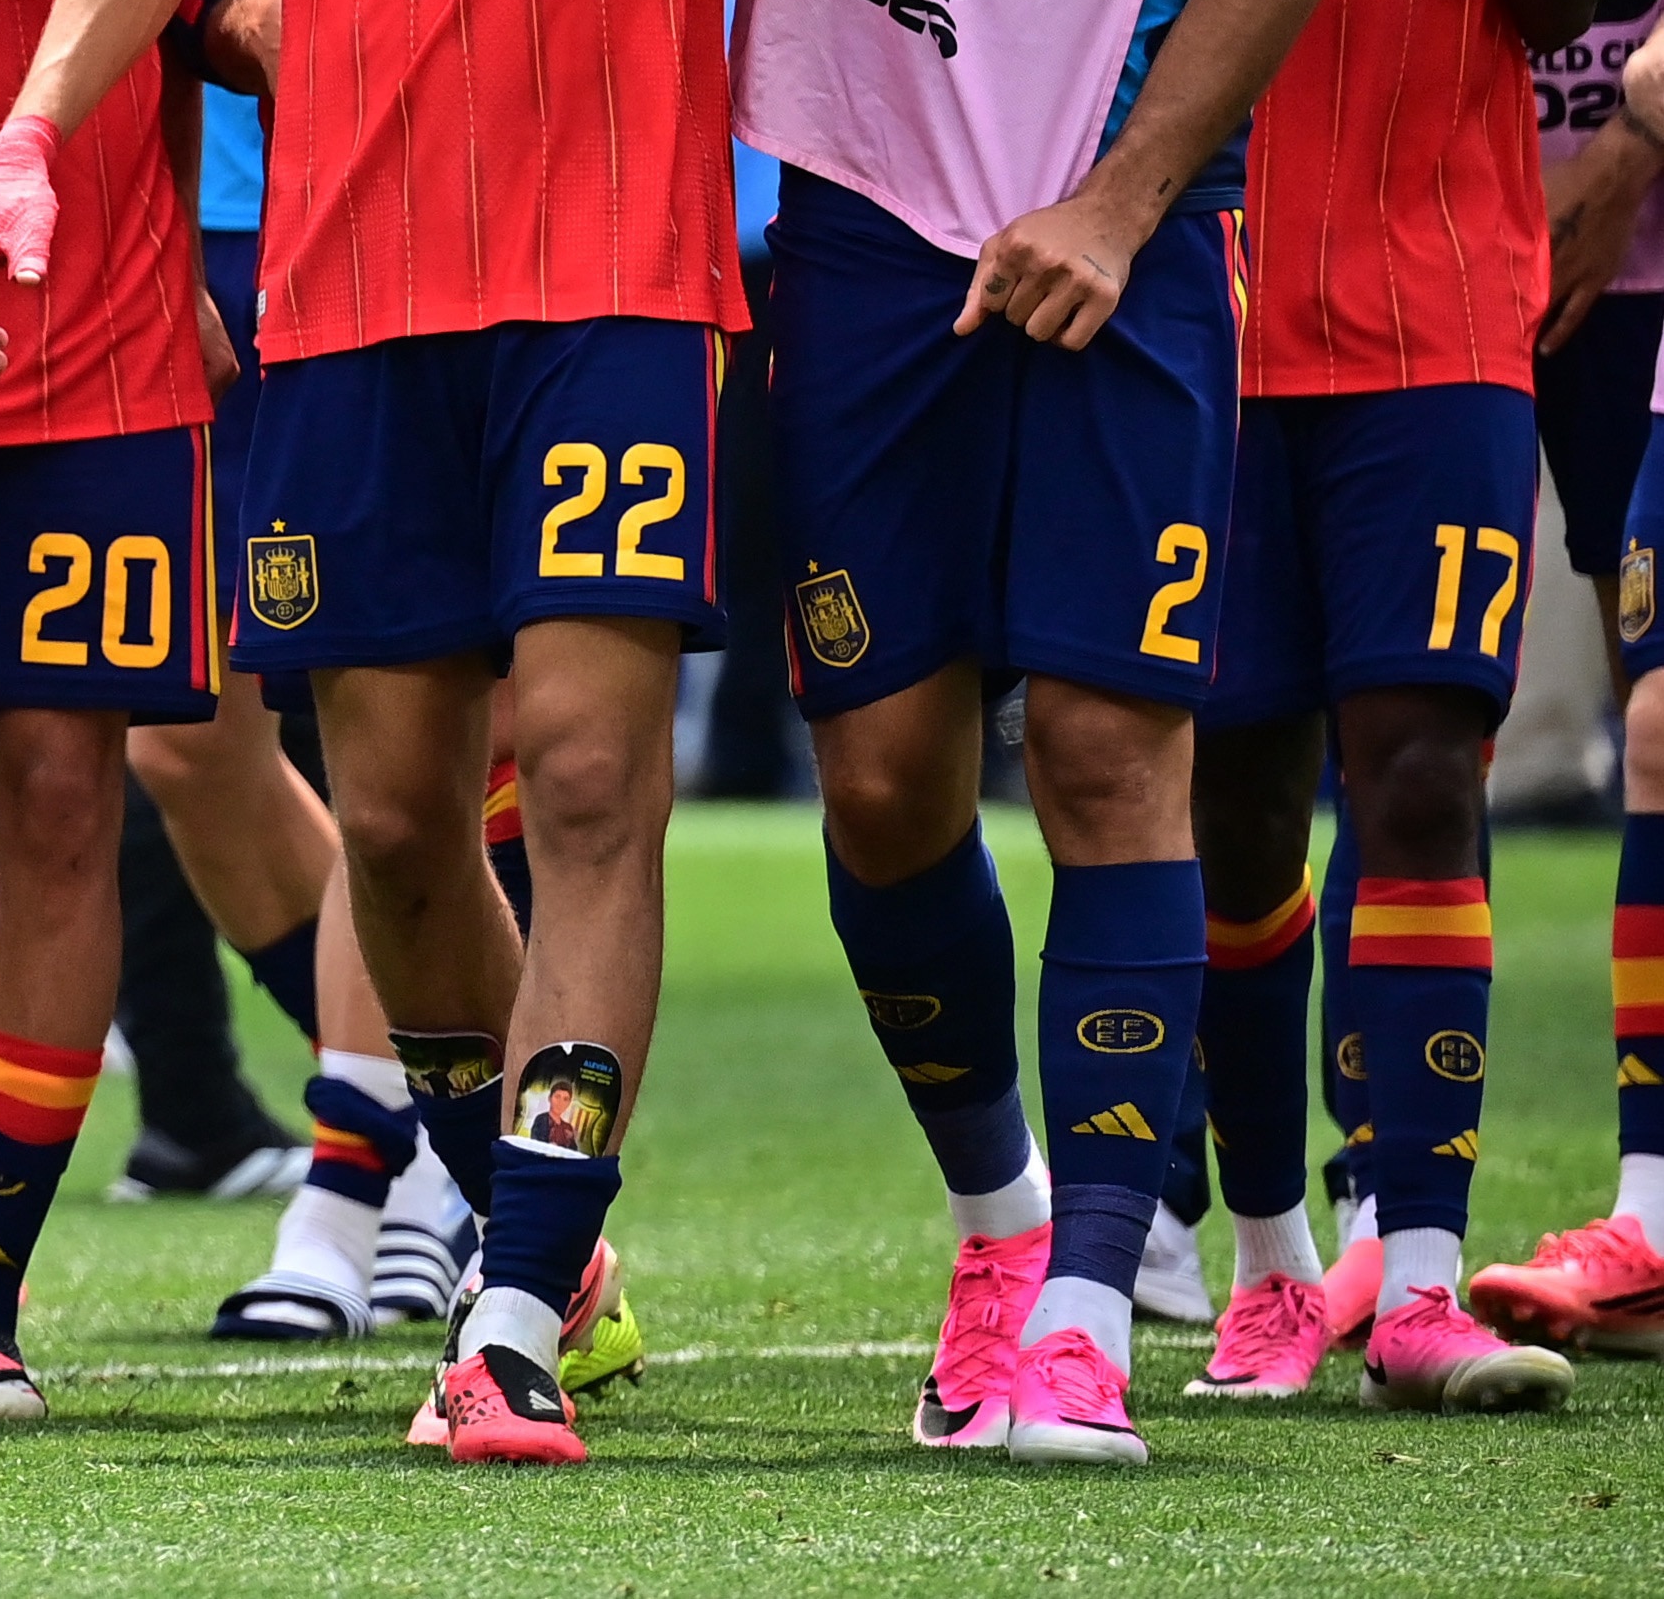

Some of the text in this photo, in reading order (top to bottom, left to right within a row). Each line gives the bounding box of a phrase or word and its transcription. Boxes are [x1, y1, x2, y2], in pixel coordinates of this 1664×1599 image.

[538, 441, 687, 582] 22
[20, 531, 172, 669] 20
[1139, 521, 1210, 665] 2
[1427, 523, 1519, 659] 17
